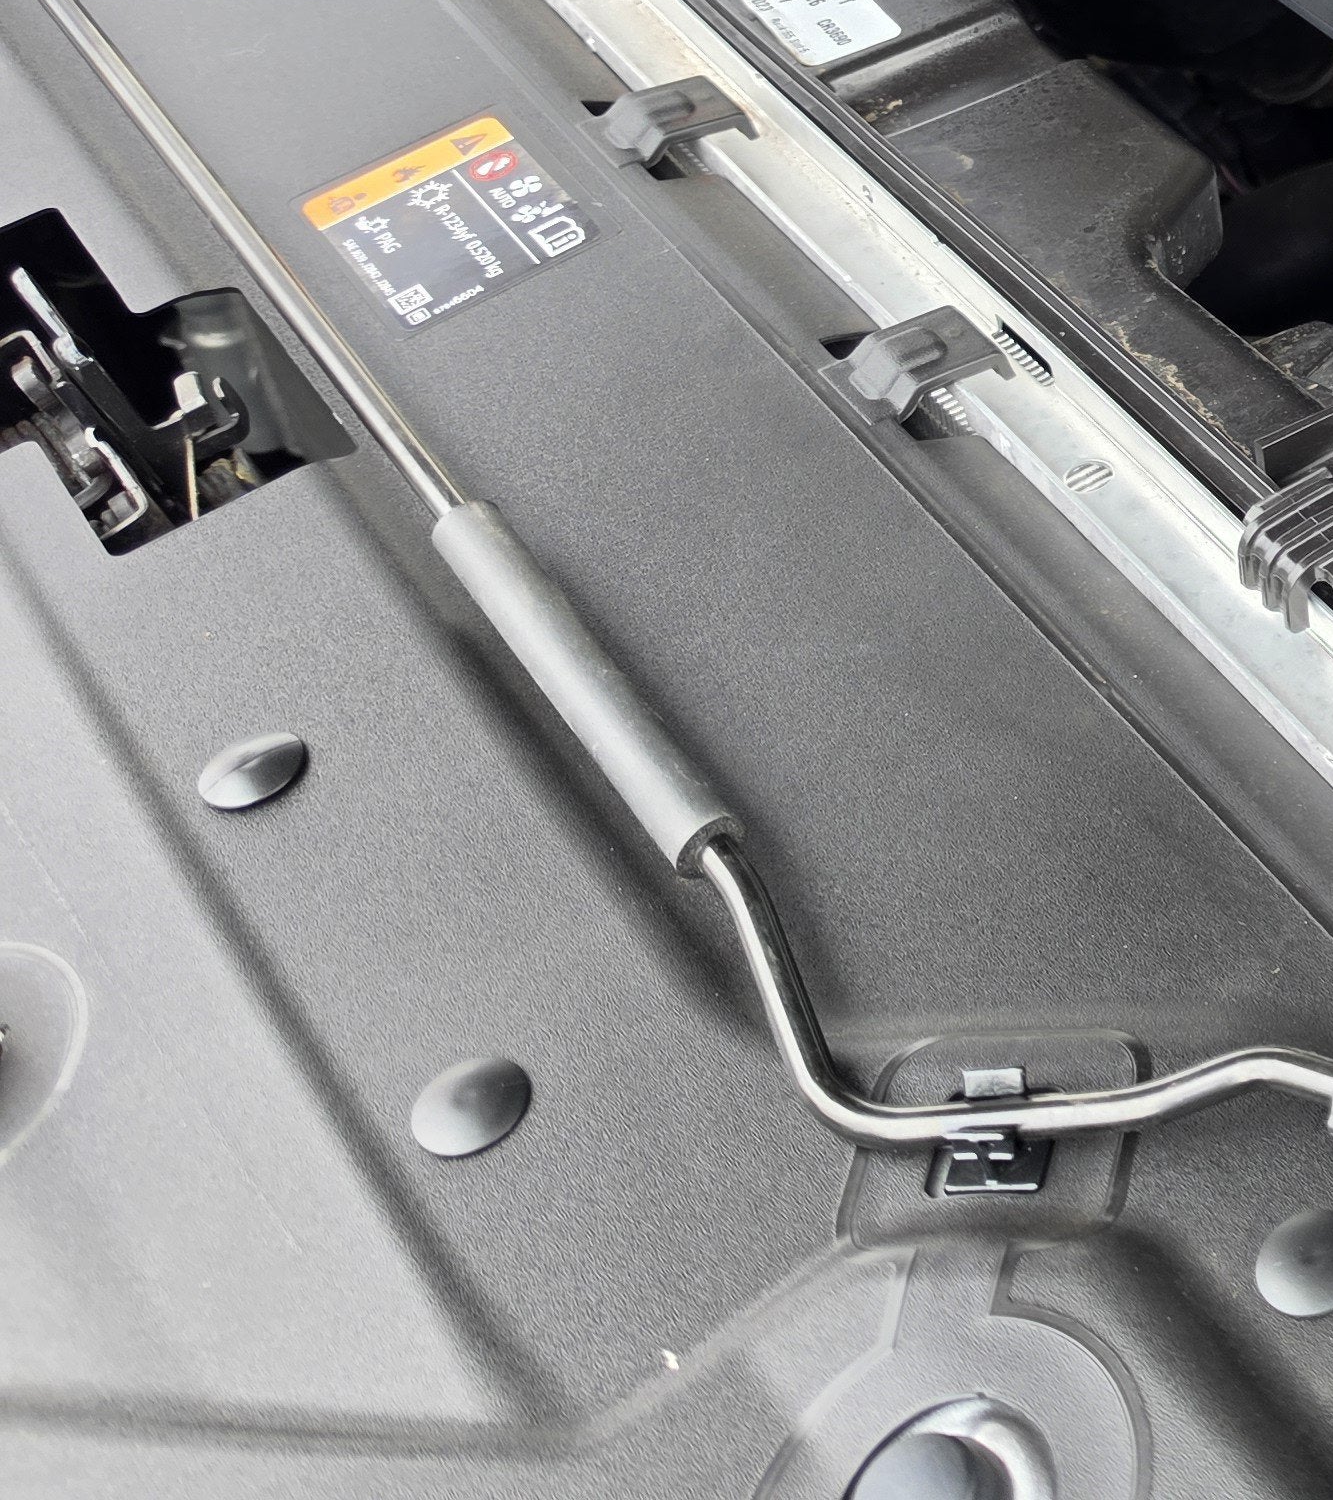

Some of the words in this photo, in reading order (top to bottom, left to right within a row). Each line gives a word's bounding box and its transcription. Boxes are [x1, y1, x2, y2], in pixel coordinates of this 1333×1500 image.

[489, 187, 516, 209] AUTO
[433, 203, 476, 240] R-1234yf
[373, 231, 402, 254] PAG
